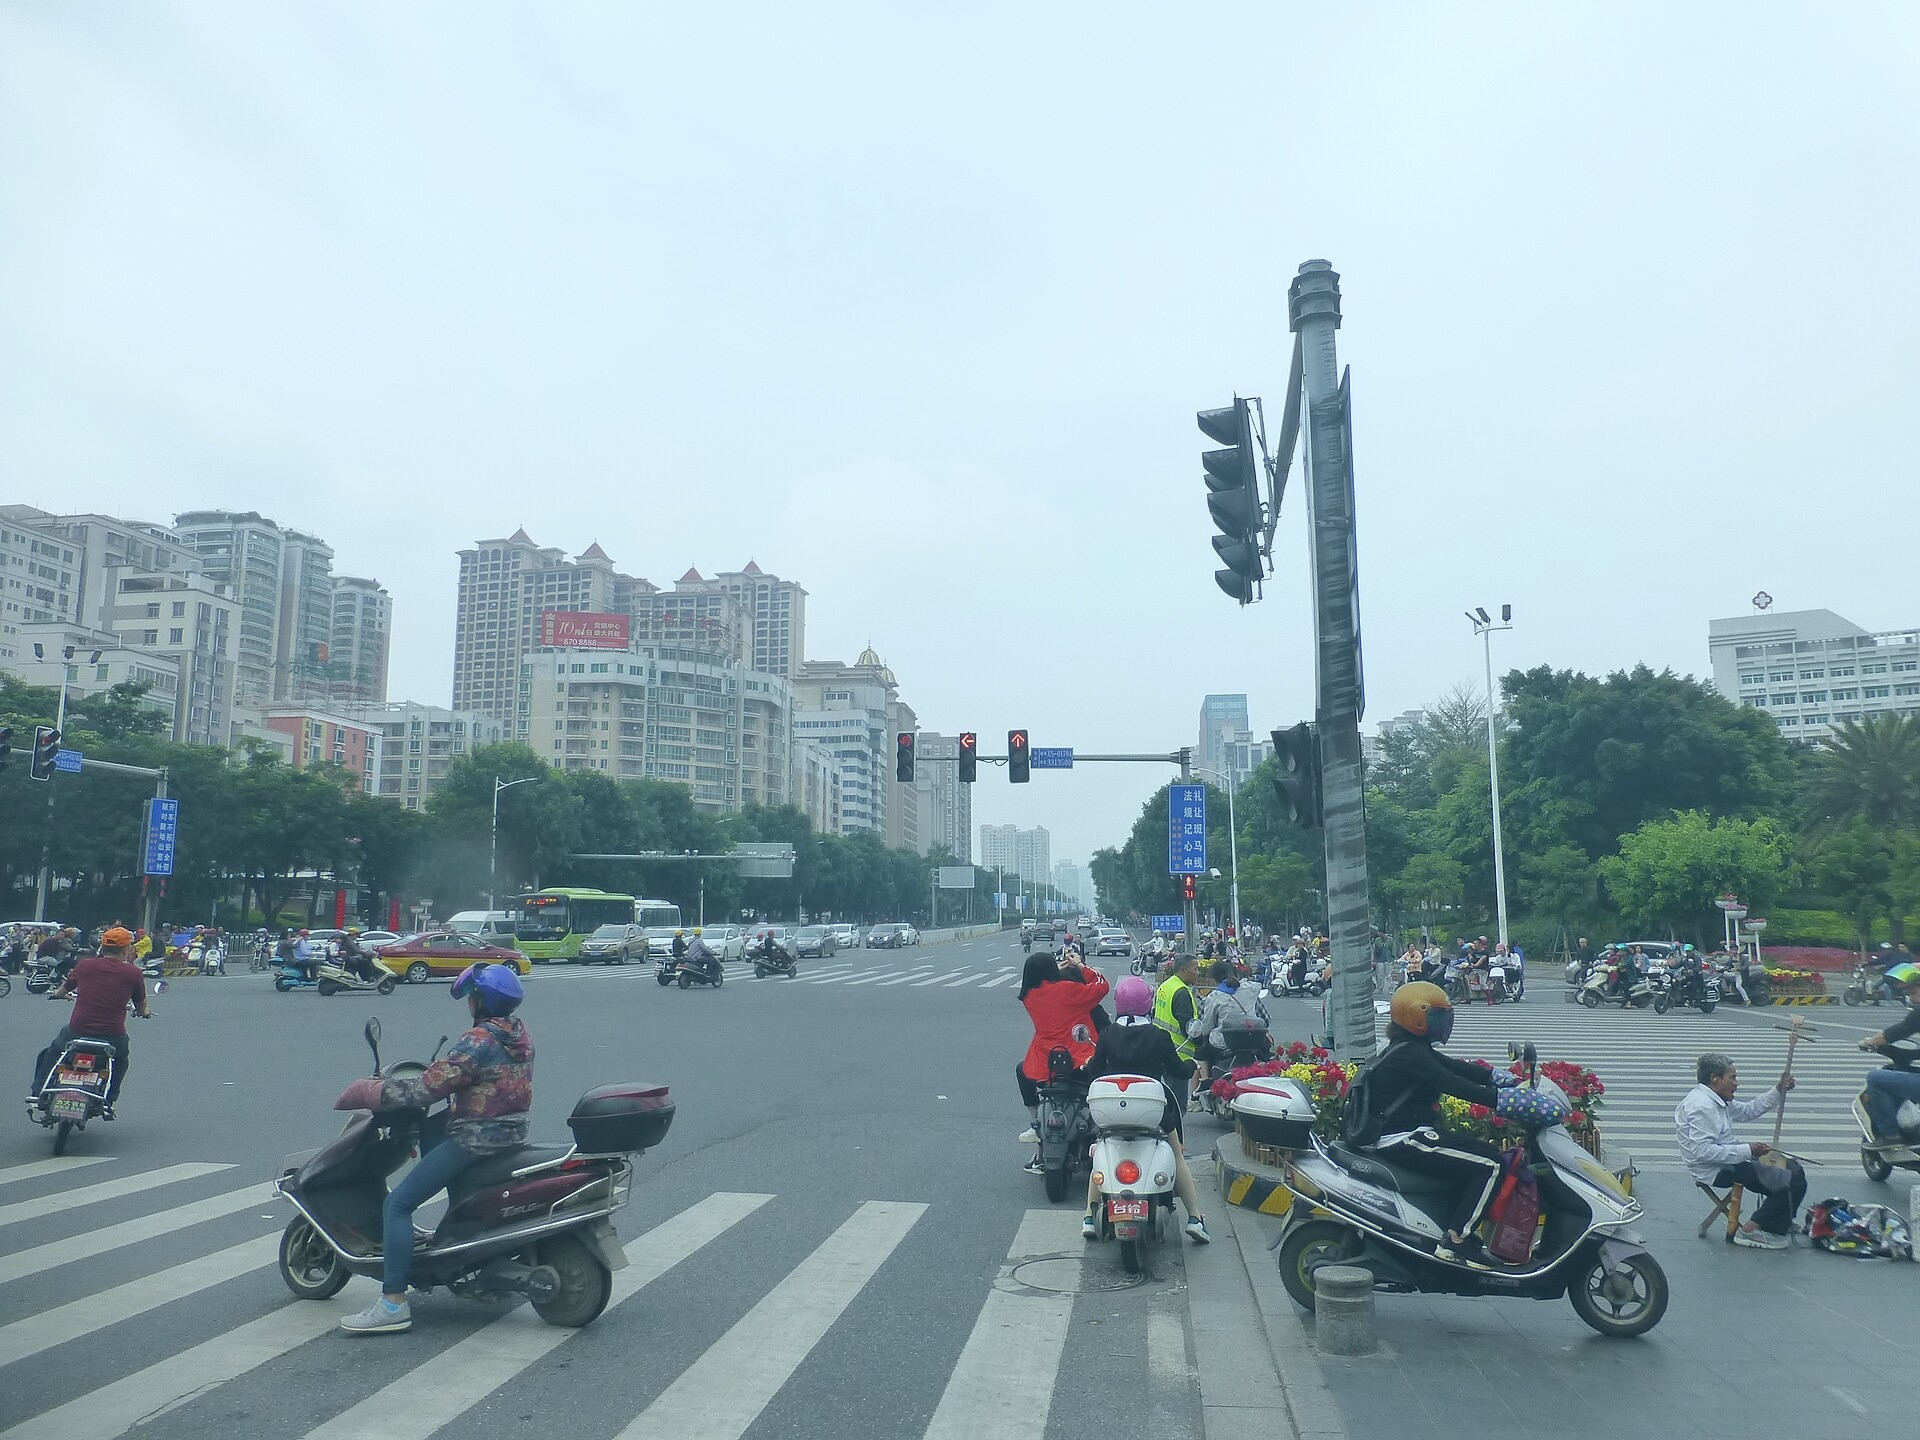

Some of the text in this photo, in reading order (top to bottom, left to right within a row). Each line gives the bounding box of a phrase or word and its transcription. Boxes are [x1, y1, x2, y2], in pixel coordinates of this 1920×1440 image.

[163, 803, 175, 871] 开车不系安全带
[1183, 790, 1193, 869] 法规记心中
[1193, 790, 1203, 869] 礼让斑马线
